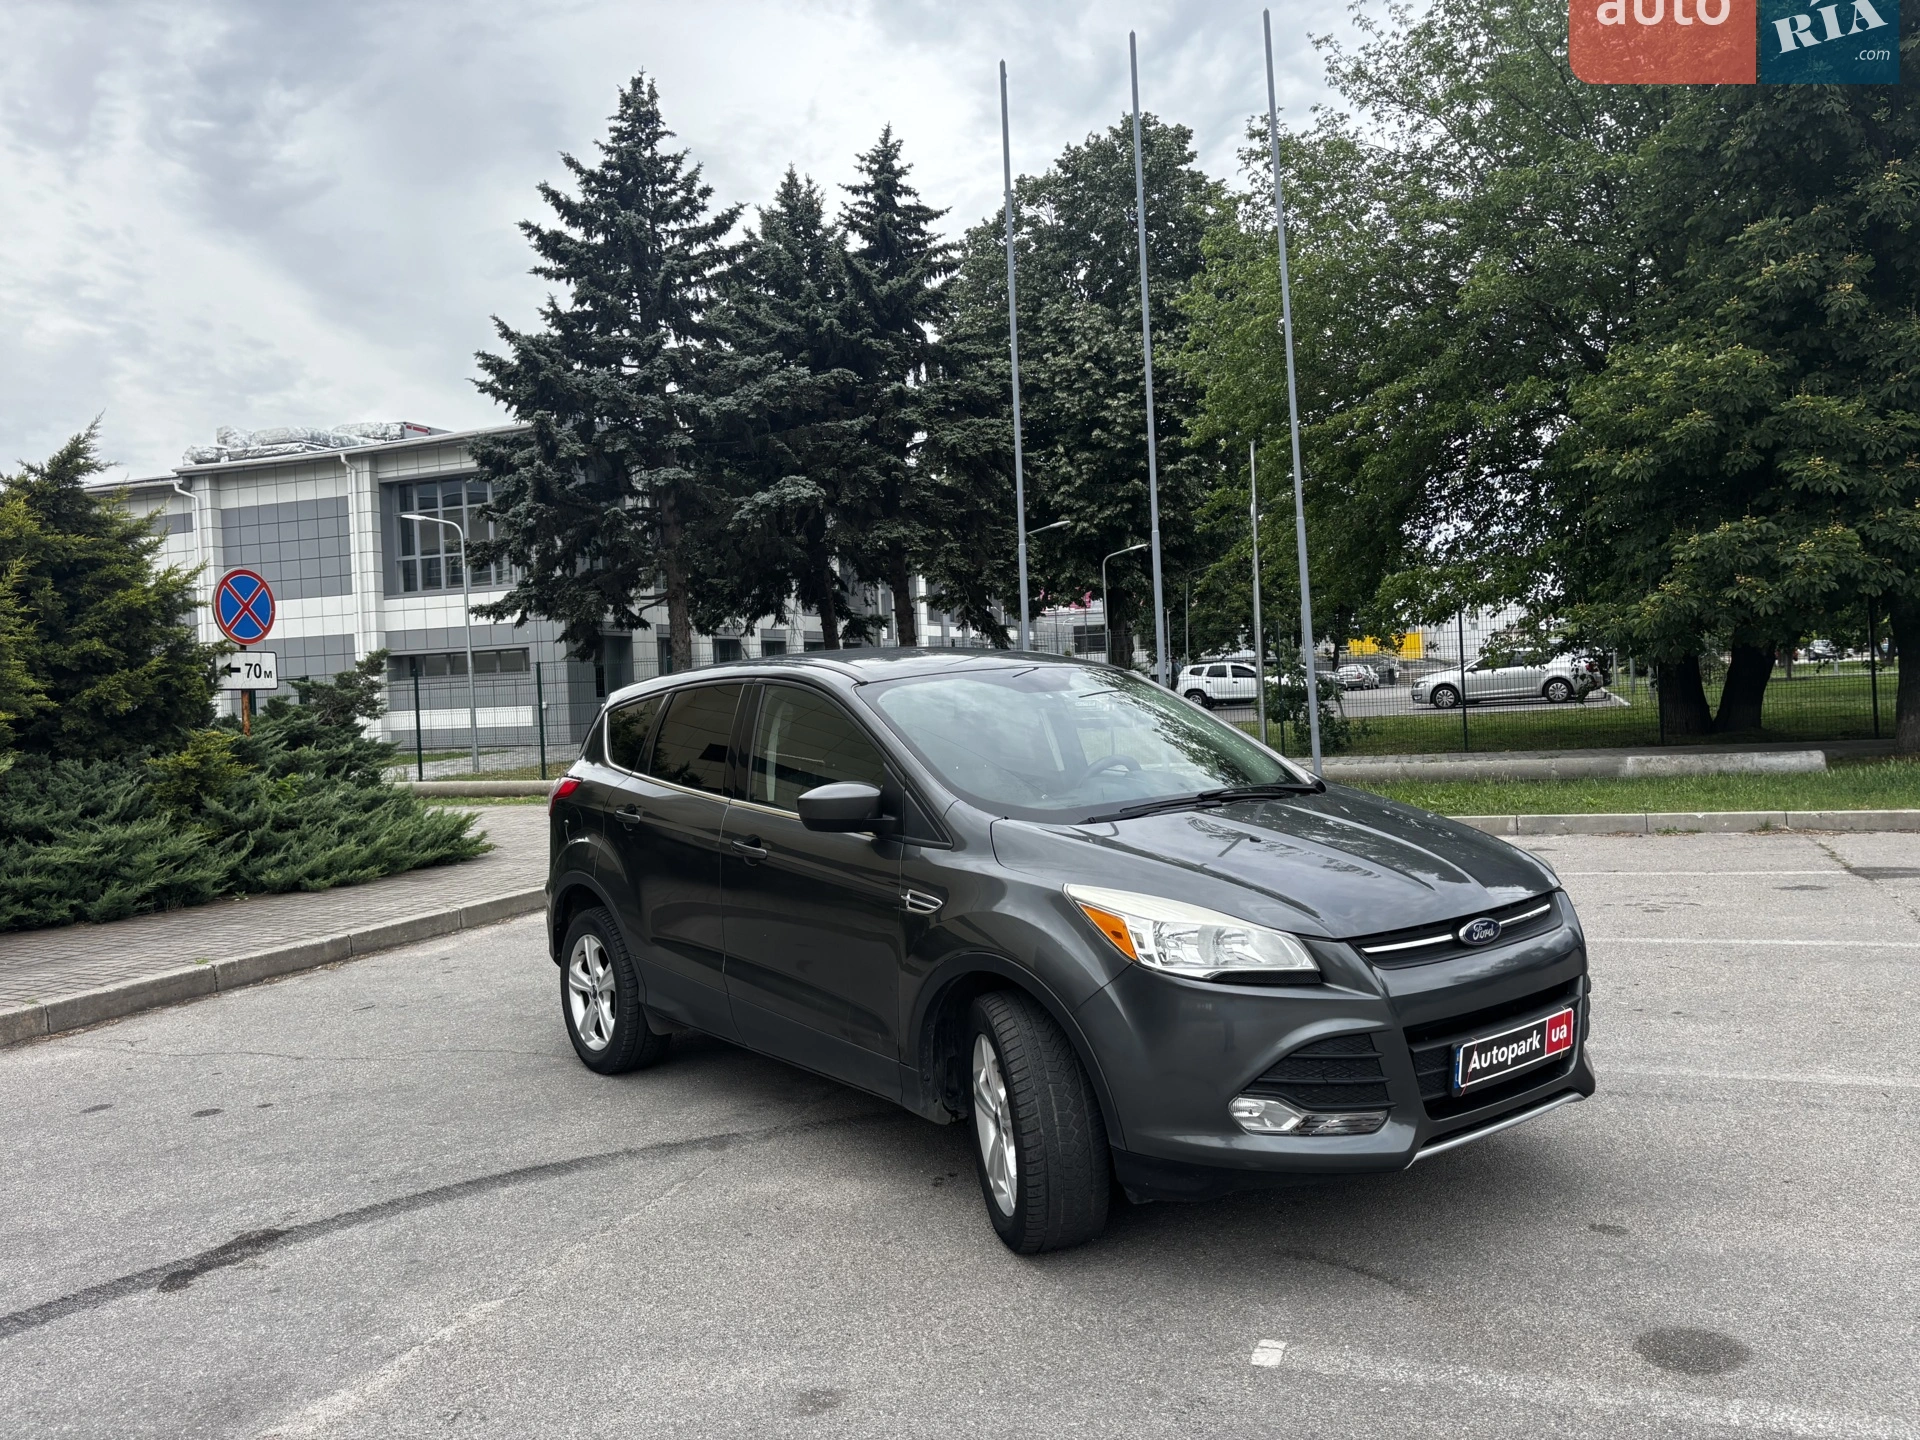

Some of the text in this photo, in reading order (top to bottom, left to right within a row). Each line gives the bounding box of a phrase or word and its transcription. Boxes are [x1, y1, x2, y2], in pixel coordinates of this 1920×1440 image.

[1472, 921, 1495, 941] Ford
[1467, 1023, 1568, 1073] Autopark ua
